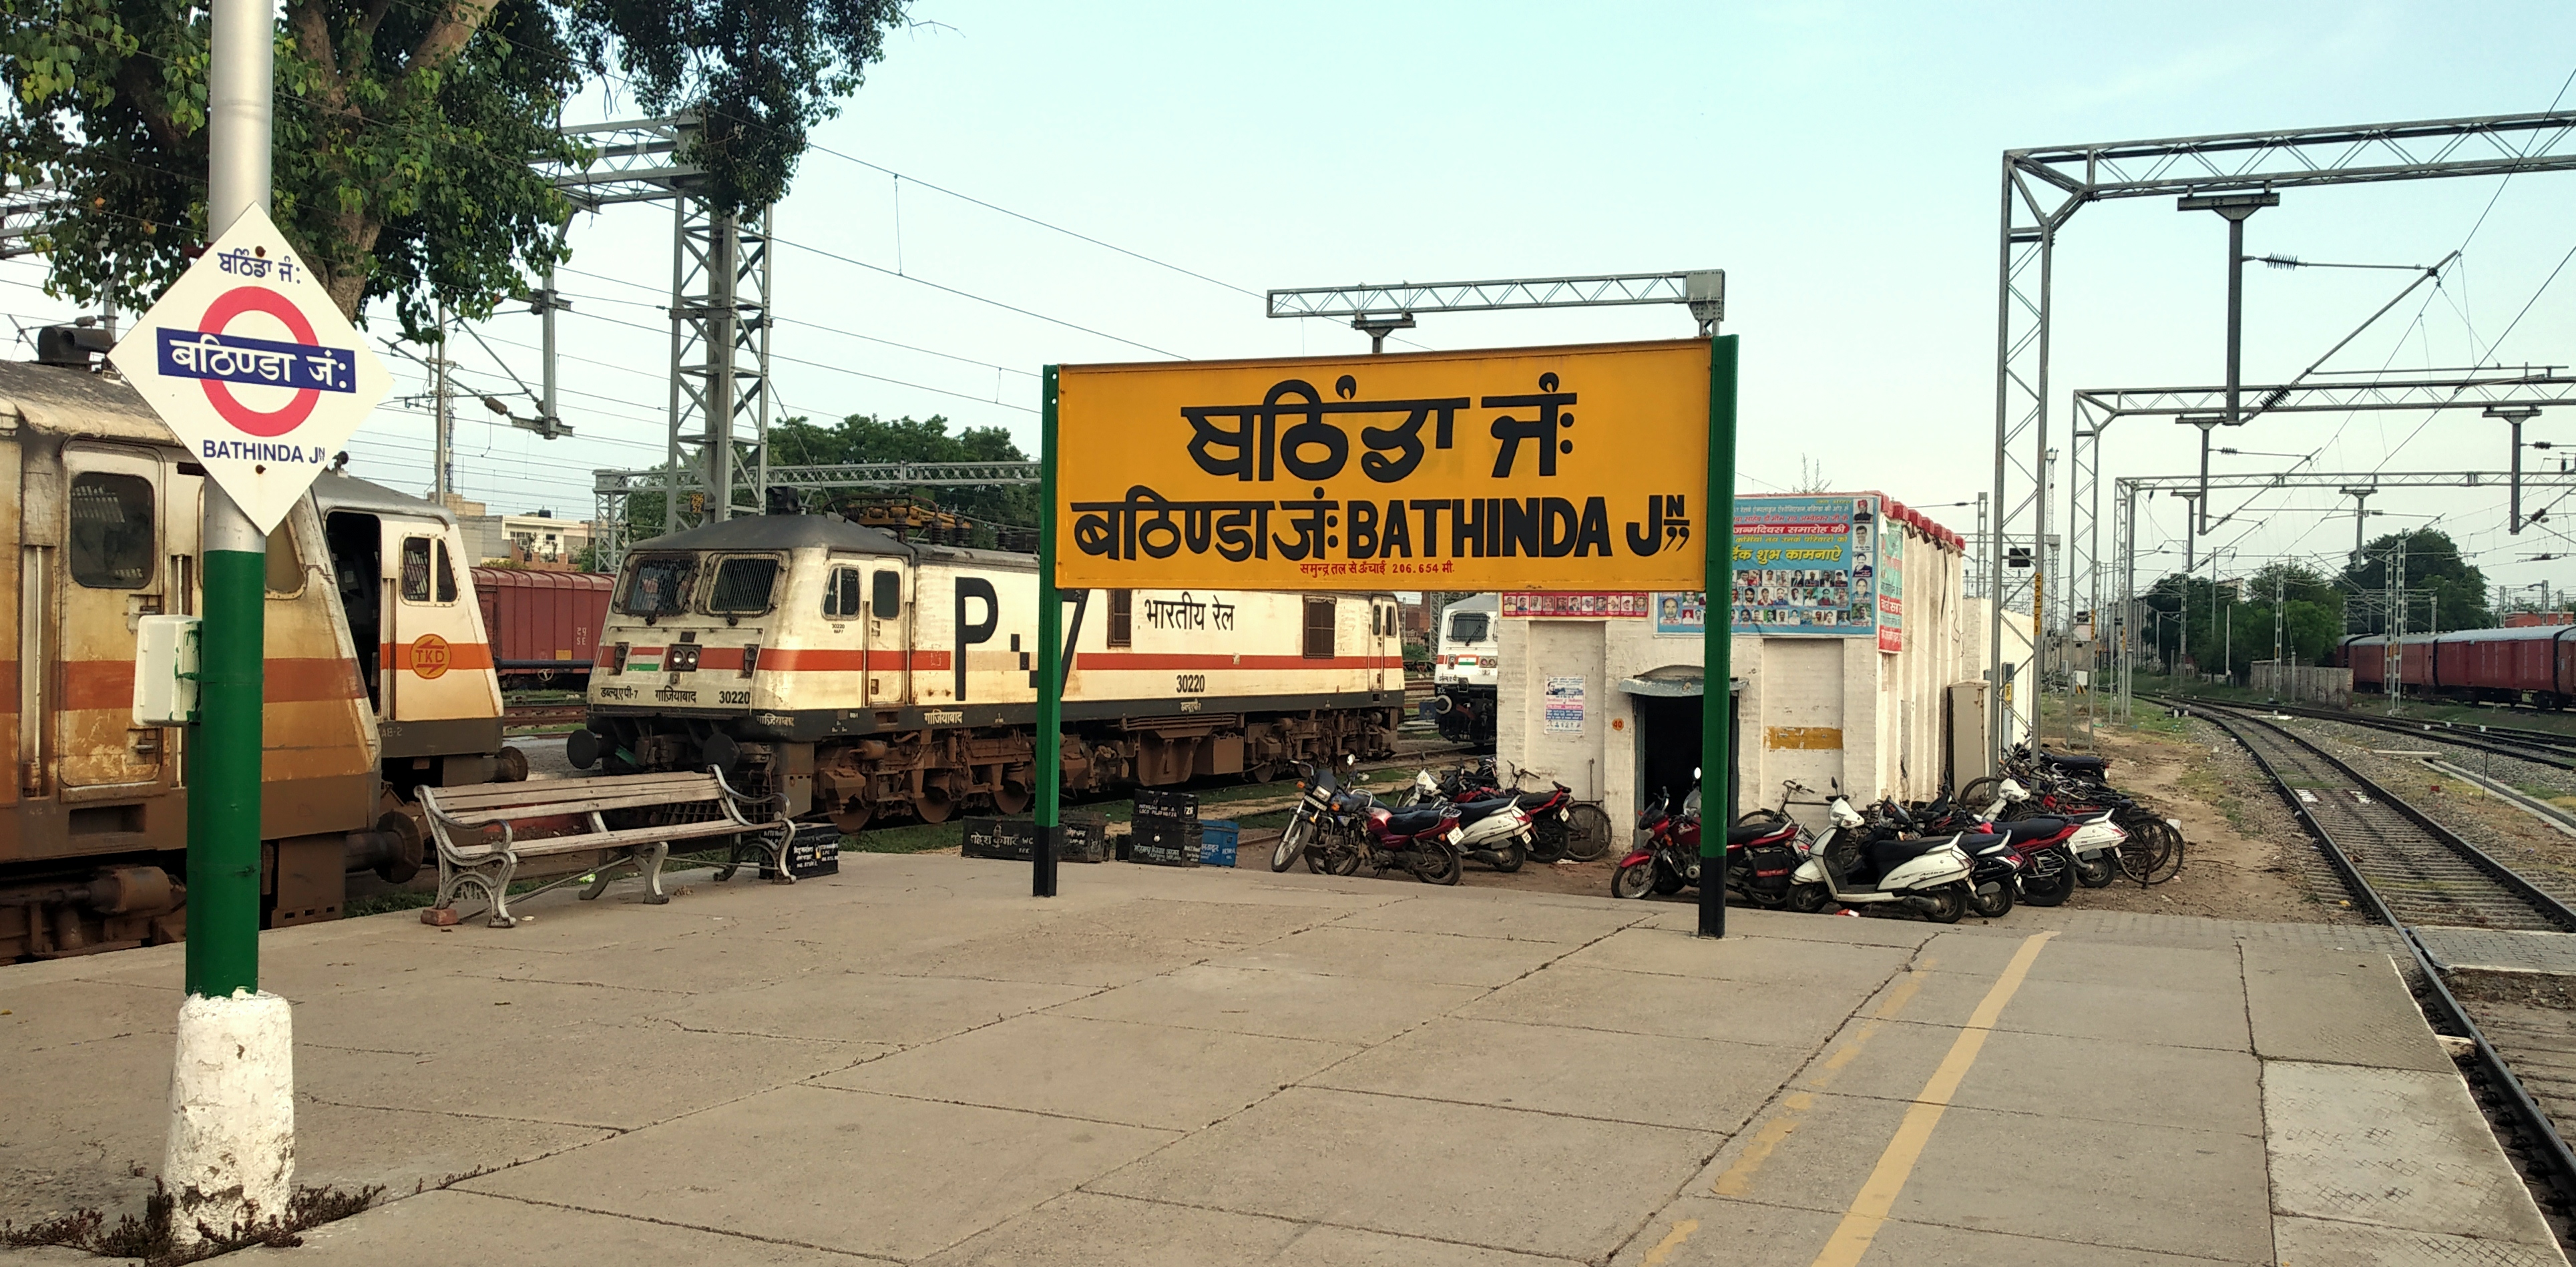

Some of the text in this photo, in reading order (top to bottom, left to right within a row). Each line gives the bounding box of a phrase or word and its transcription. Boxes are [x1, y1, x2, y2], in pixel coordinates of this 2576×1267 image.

[169, 333, 297, 383] बठिण्डा
[1180, 374, 1470, 483] ਬਠਿੰਡਾ
[203, 439, 304, 463] BATHINDA
[1354, 495, 1613, 560] BATHINDA
[1787, 523, 1829, 534] समारोह
[1830, 523, 1846, 533] की
[1757, 549, 1781, 566] शुभ
[1331, 563, 1346, 575] तल
[1348, 560, 1357, 574] से
[1392, 563, 1439, 573] 206.654
[1144, 591, 1235, 631] भारतीय रेल
[415, 650, 445, 663] TKD
[1176, 674, 1205, 693] 30220
[718, 690, 750, 704] 30220
